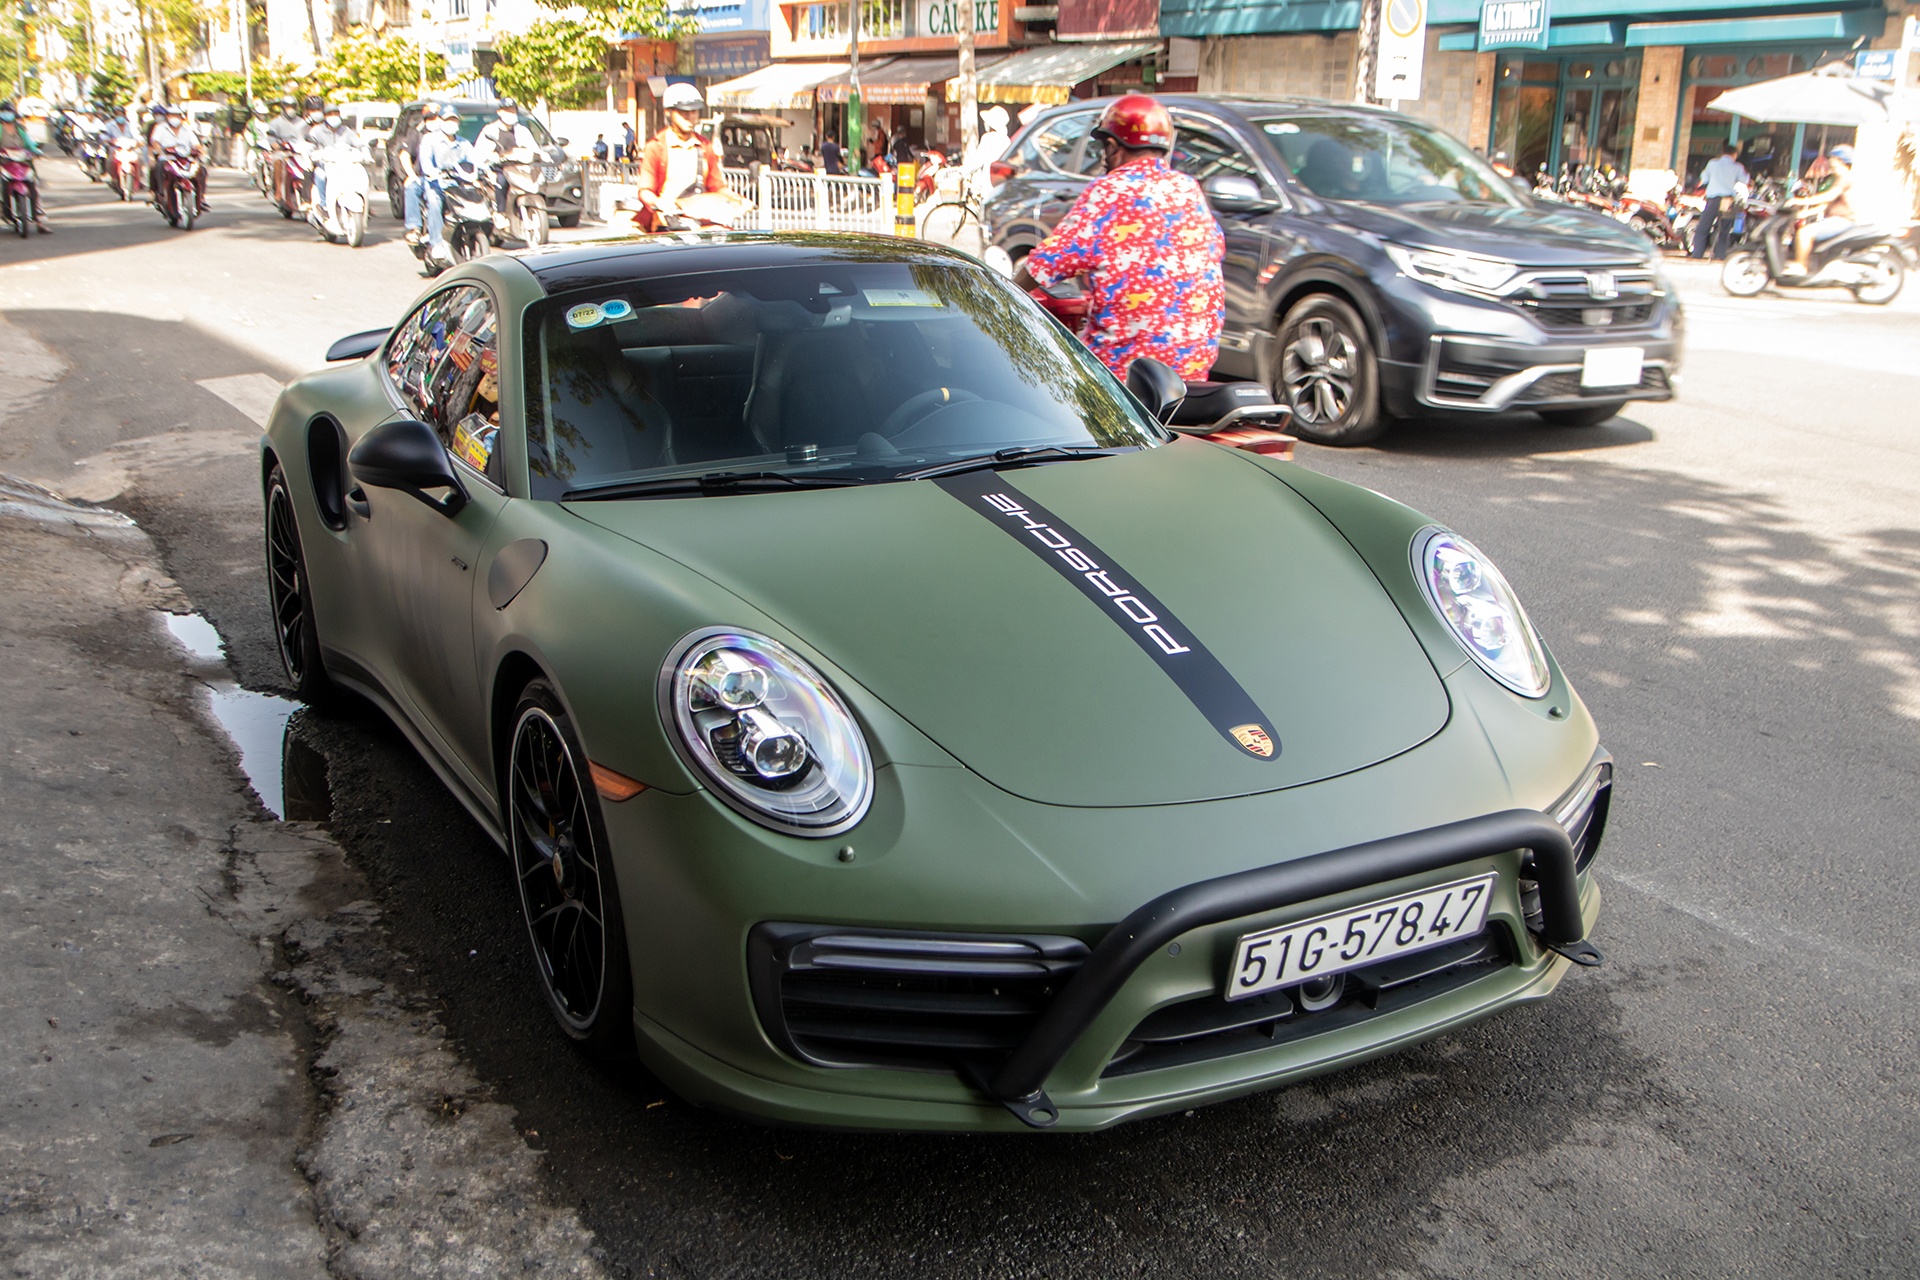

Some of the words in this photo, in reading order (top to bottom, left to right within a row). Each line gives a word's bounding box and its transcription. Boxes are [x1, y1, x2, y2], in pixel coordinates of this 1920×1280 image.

[573, 309, 595, 319] 07/22
[981, 493, 1191, 655] PORSCHE
[1240, 884, 1486, 988] 51G-578.47
